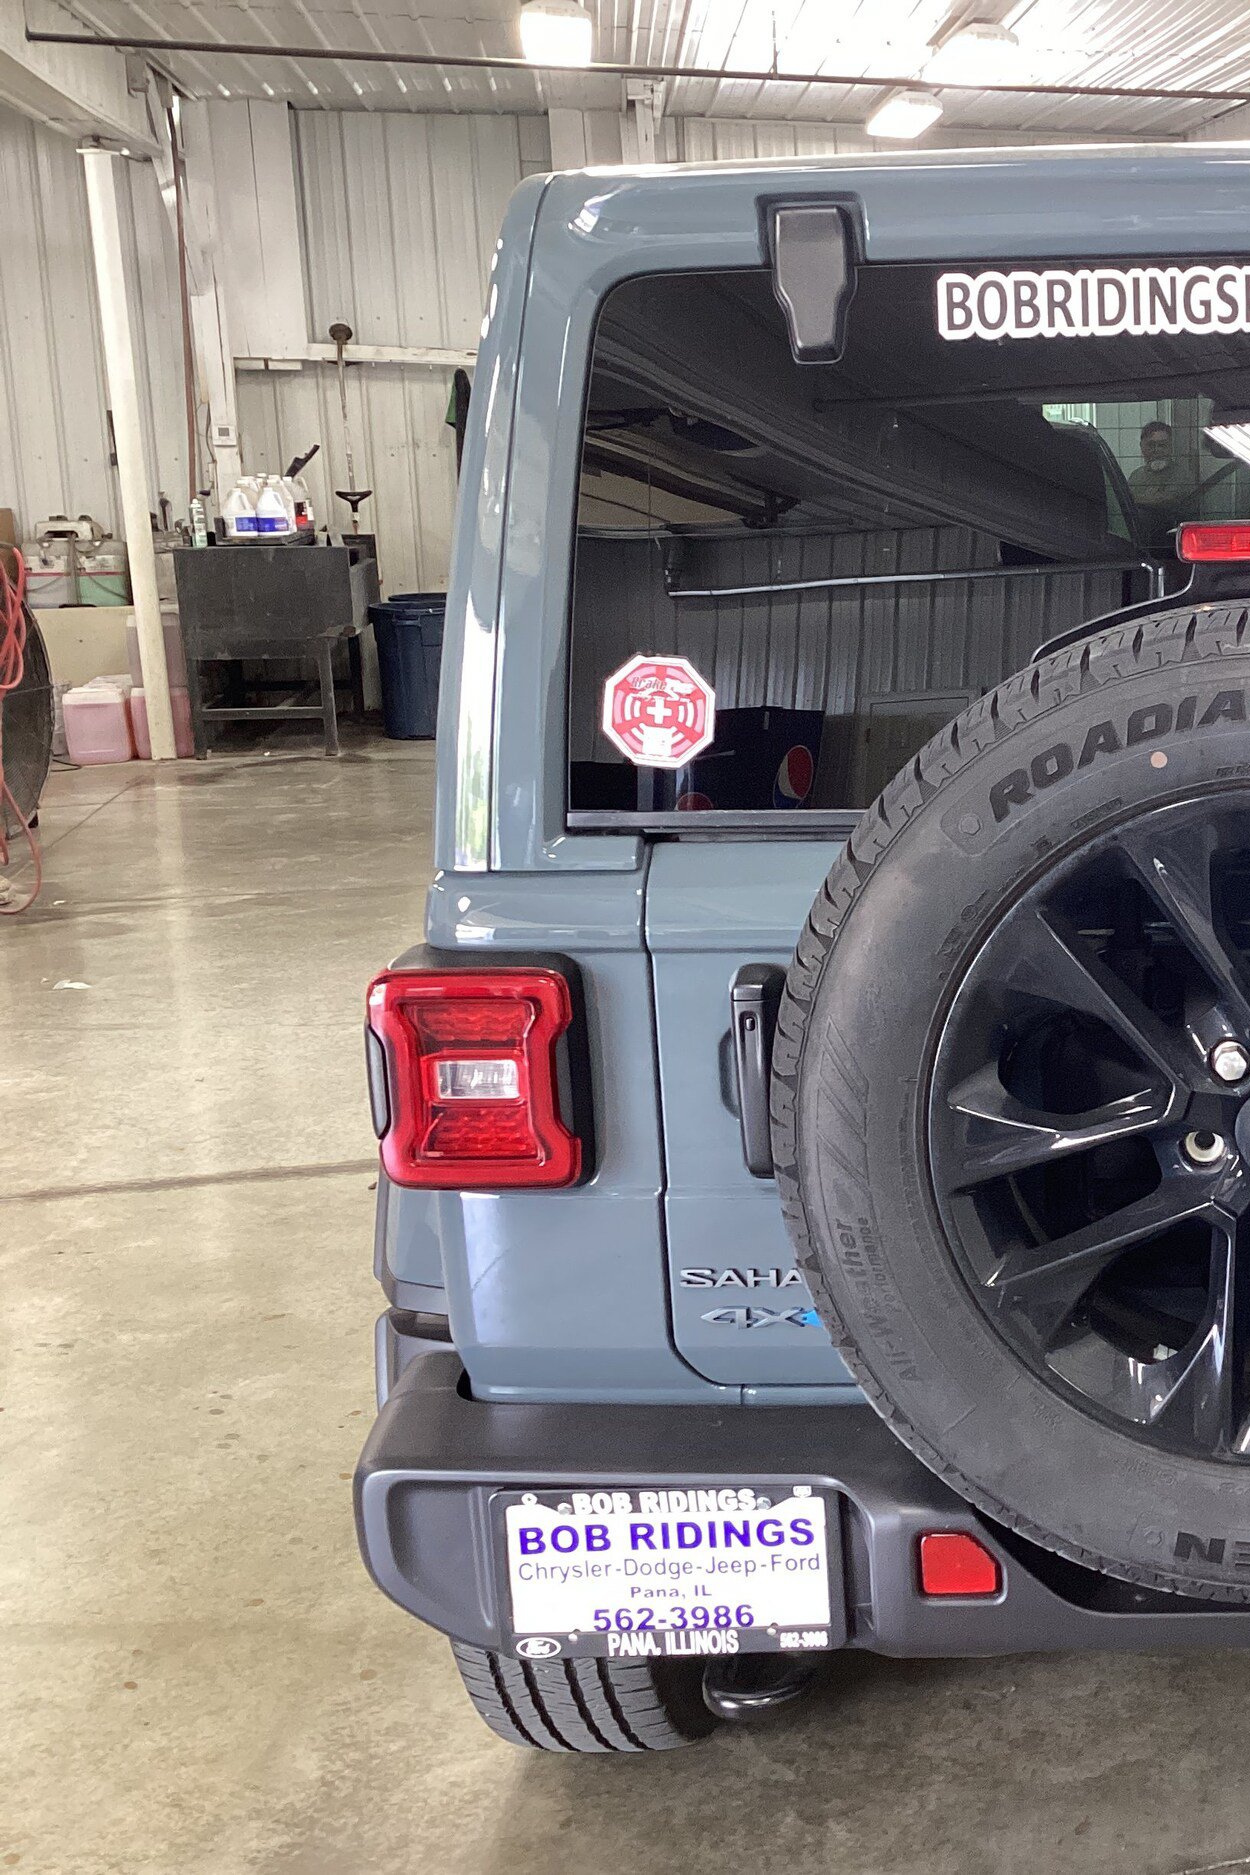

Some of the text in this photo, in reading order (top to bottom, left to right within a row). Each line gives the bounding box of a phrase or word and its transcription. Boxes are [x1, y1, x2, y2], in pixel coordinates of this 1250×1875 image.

[572, 1488, 756, 1514] BOB RIDINGS
[519, 1518, 815, 1555] BOB RIDINGS
[630, 1584, 713, 1599] Pana, IL
[593, 1604, 755, 1632] 562-3986
[664, 1629, 740, 1655] ILLINOIS
